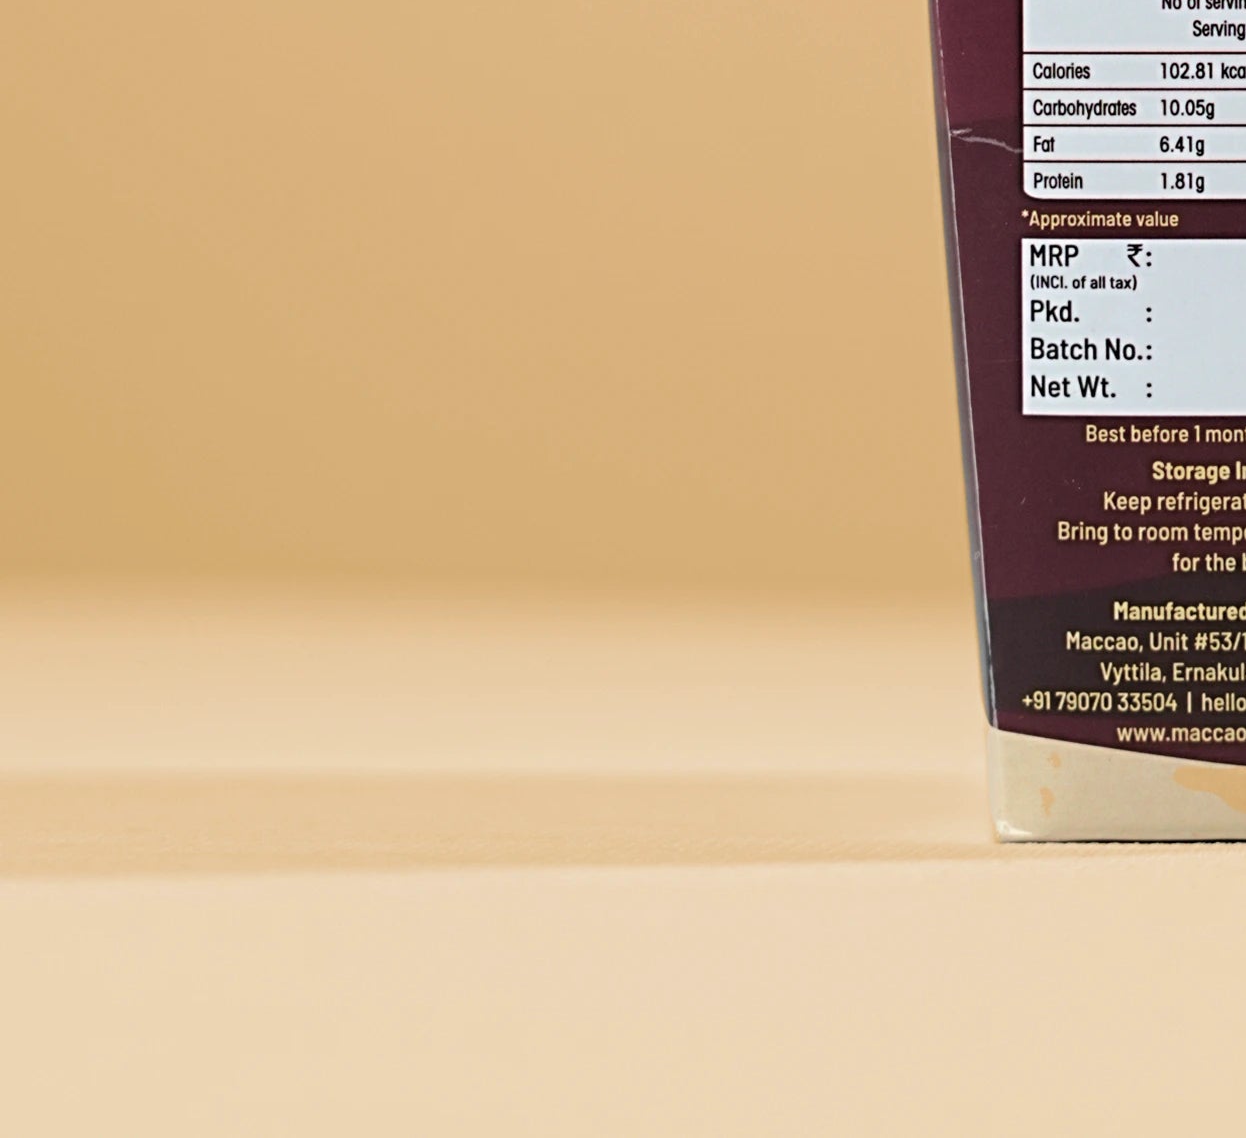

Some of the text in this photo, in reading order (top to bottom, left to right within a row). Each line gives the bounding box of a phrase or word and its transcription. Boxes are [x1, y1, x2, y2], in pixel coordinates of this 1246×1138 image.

[1192, 19, 1246, 42] Serving
[1032, 61, 1091, 80] Calories
[1160, 61, 1213, 80] 102.81
[1032, 98, 1137, 120] Carbohydrates
[1160, 98, 1215, 121] 10.05g
[1033, 135, 1056, 153] Fat
[1159, 135, 1205, 157] 6.41g
[1033, 172, 1084, 190] Protein
[1160, 172, 1205, 194] 1.81g
[1135, 210, 1179, 227] value
[1030, 243, 1079, 268] MRP
[1072, 275, 1087, 290] of
[1089, 275, 1106, 290] all
[1109, 274, 1138, 291] tax)
[1030, 299, 1080, 323] Pkd.
[1030, 336, 1098, 361] Batch
[1030, 374, 1071, 398] Net
[1077, 375, 1117, 399] Wt.
[1085, 424, 1126, 443] Best
[1130, 424, 1189, 443] before
[1193, 424, 1201, 443] 1
[1152, 460, 1231, 485] Storage
[1103, 491, 1152, 516] Keep
[1057, 520, 1109, 546] Bring
[1113, 523, 1133, 541] to
[1138, 526, 1189, 541] room
[1171, 552, 1201, 572] for
[1204, 552, 1237, 572] the
[1066, 630, 1144, 653] Maccao,
[1149, 631, 1189, 652] Unit
[1100, 661, 1167, 686] Vyttila,
[1022, 690, 1051, 710] +91
[1055, 691, 1113, 712] 79070
[1117, 692, 1178, 712] 33504
